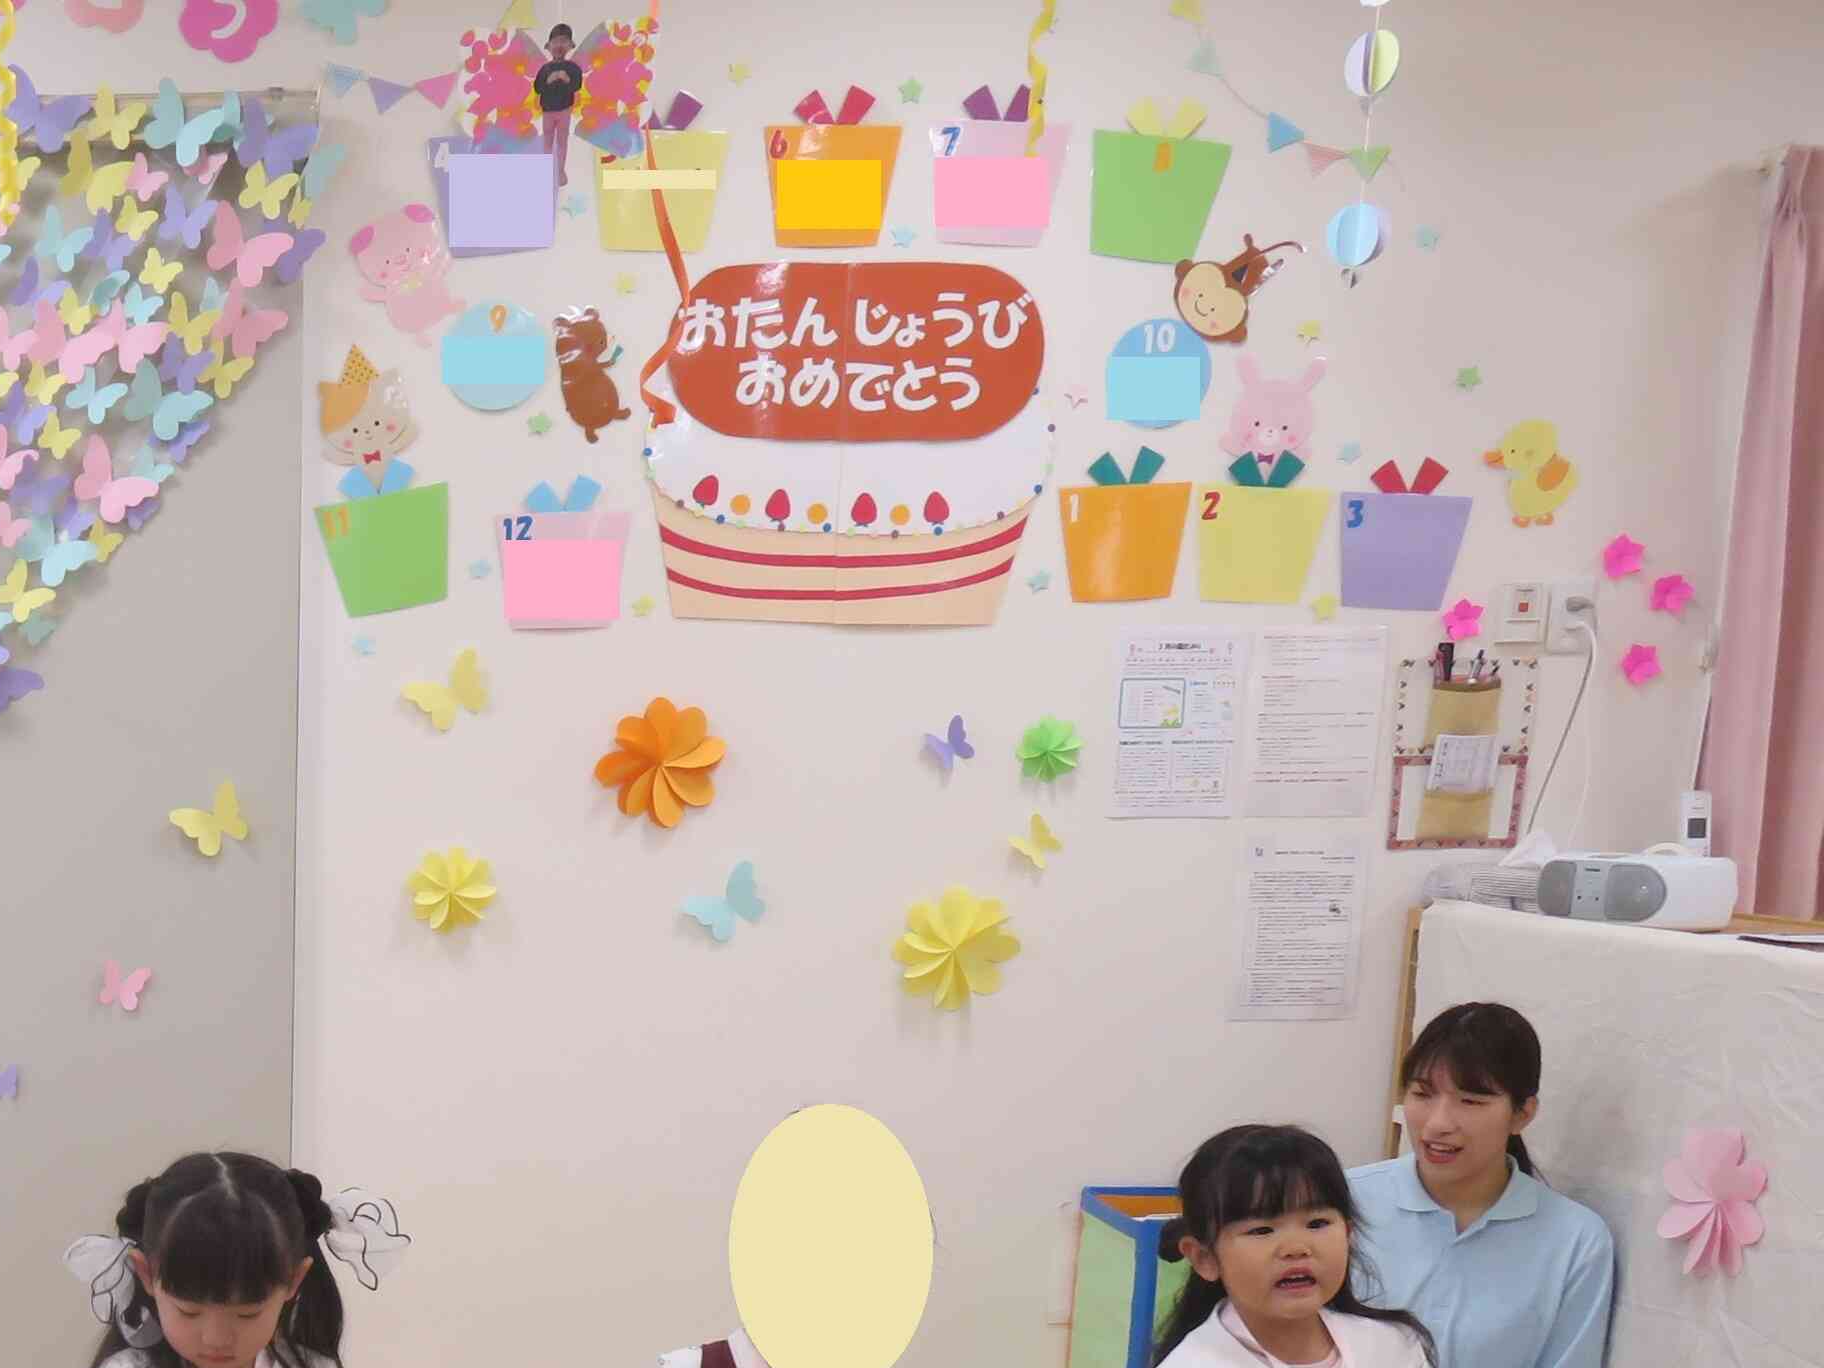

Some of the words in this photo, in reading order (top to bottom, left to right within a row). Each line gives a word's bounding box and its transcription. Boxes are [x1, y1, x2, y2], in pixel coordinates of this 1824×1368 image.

[769, 130, 788, 159] 6
[941, 127, 961, 156] 7
[1143, 323, 1176, 355] 10
[736, 352, 980, 412] おめでとう
[1068, 493, 1081, 523] 1
[1200, 491, 1221, 520] 2
[1346, 499, 1365, 528] 3
[324, 505, 350, 540] 11
[503, 515, 534, 541] 12
